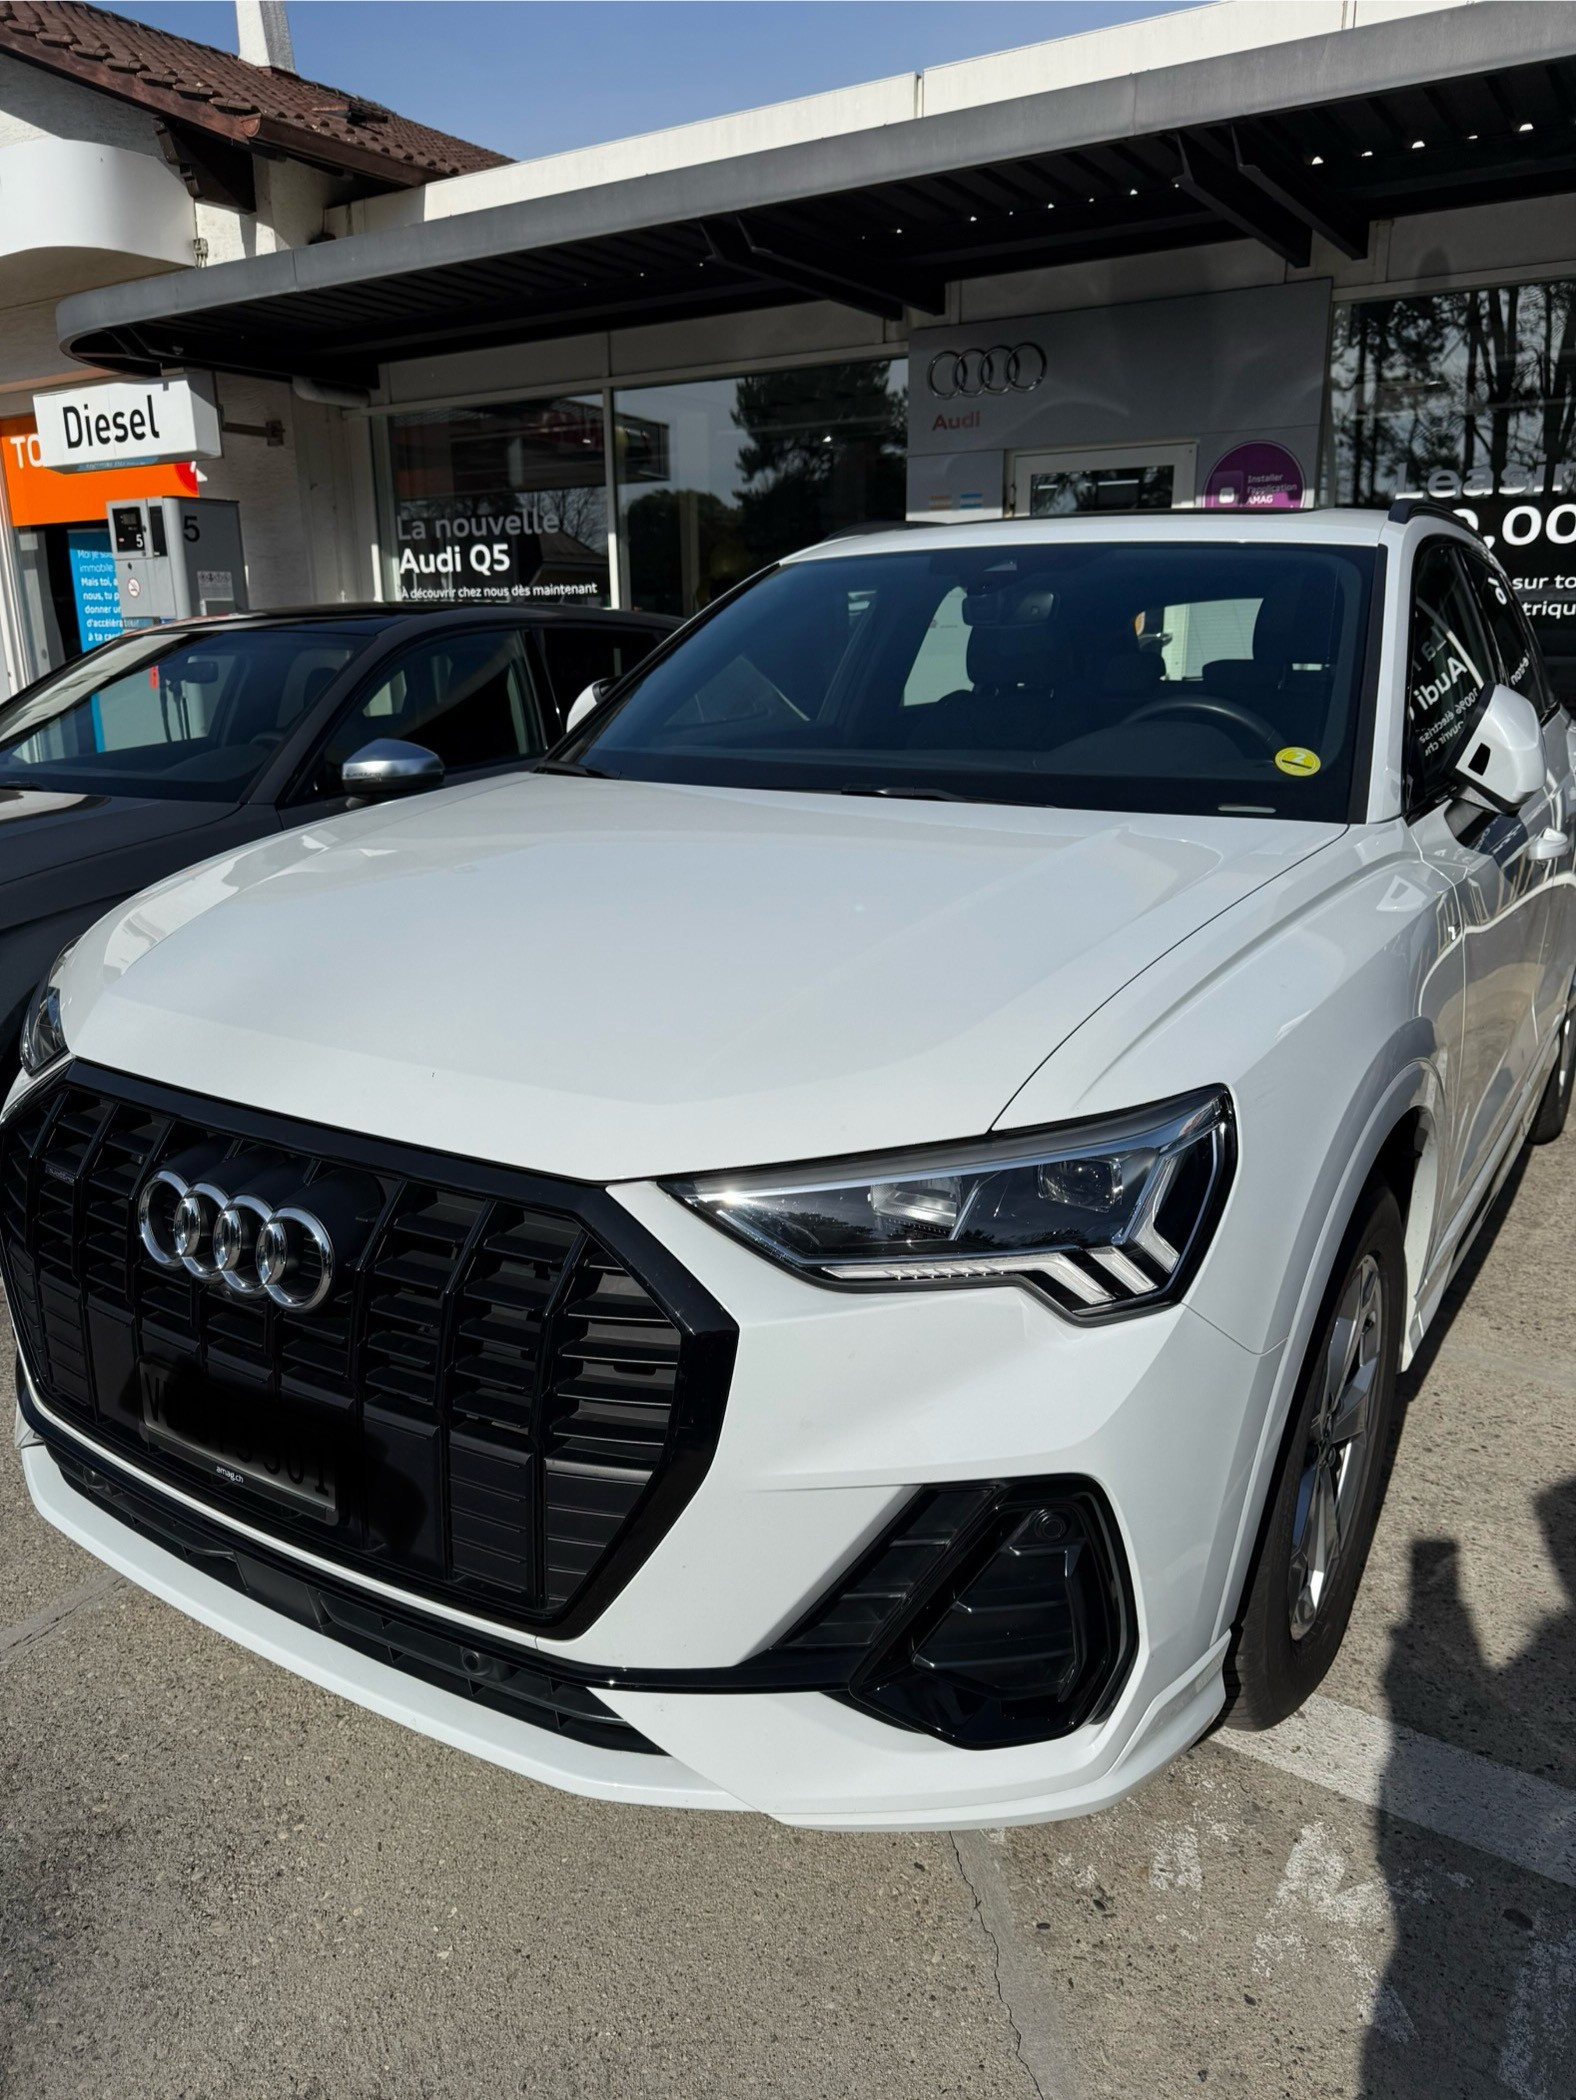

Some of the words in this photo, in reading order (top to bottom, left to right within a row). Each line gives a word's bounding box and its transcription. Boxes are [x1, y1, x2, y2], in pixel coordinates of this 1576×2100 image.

[62, 395, 160, 449] Diesel
[932, 411, 980, 431] Audi
[1248, 473, 1283, 483] Installer
[1249, 495, 1273, 504] AMAG
[183, 515, 200, 542] 5
[397, 515, 426, 540] La
[435, 509, 560, 538] nouvelle
[136, 534, 143, 547] 5
[400, 546, 462, 574] Audi
[469, 543, 510, 576] Q5
[81, 577, 99, 586] Mais
[100, 577, 112, 588] toi,
[1512, 577, 1549, 590] sur
[83, 592, 103, 602] nous,
[104, 592, 112, 600] tu
[411, 587, 456, 599] découvrir
[458, 586, 482, 597] chez
[484, 587, 509, 597] nous
[511, 585, 531, 596] dès
[533, 582, 598, 596] maintenant
[85, 605, 111, 614] donner
[216, 1465, 244, 1483] amag.ch
